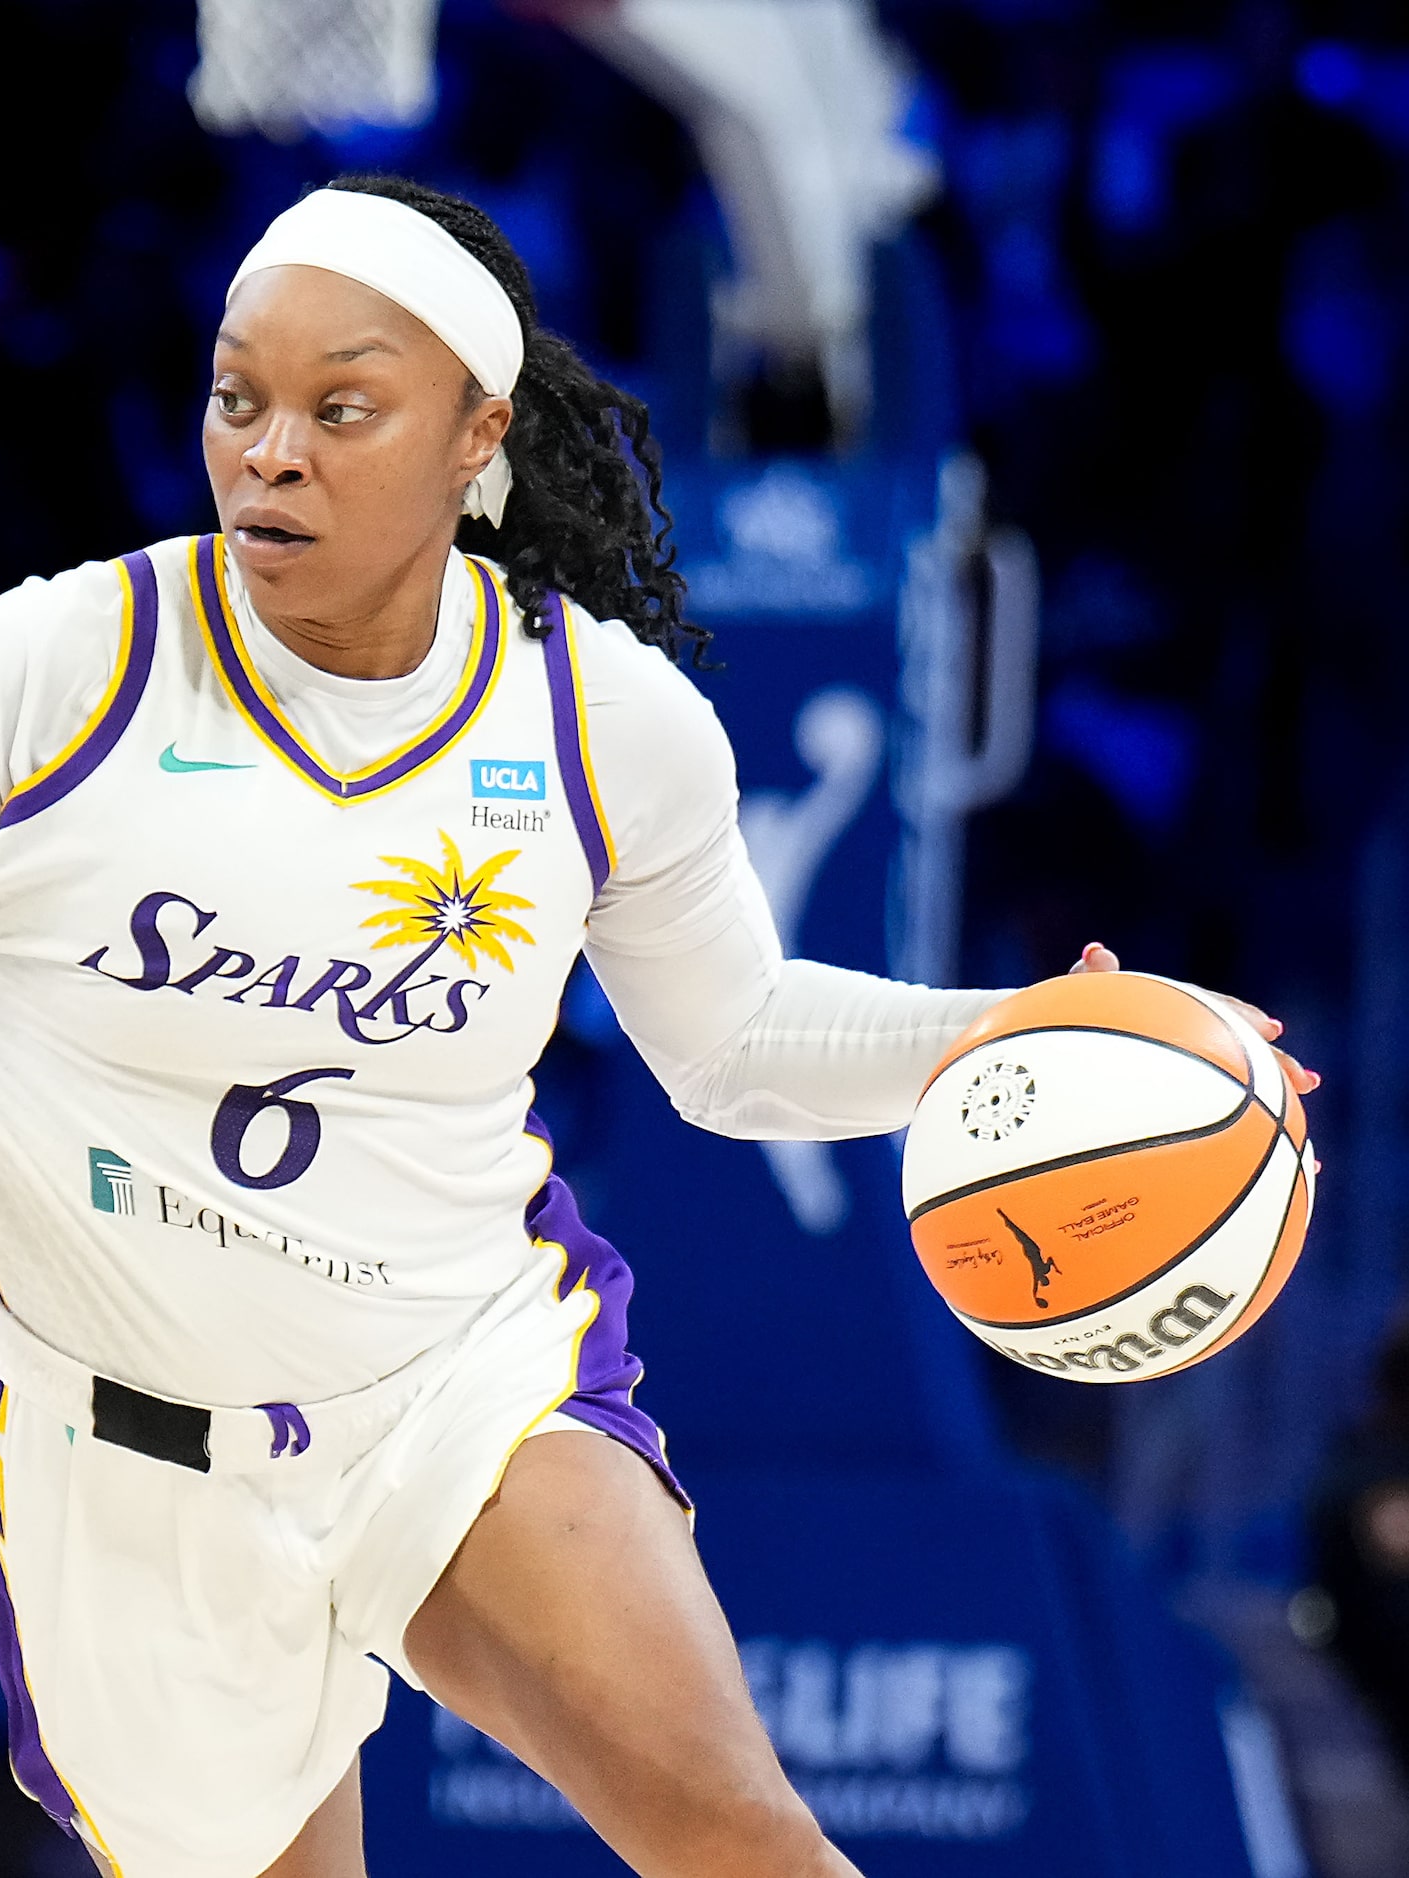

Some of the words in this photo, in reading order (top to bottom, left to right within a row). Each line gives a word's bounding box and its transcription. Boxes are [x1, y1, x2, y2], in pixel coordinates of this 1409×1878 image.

[480, 766, 539, 792] UCLA
[77, 892, 490, 1045] SPARKS
[211, 1067, 356, 1190] 6
[1095, 1196, 1139, 1221] GAME
[1057, 1215, 1095, 1233] BALL
[1071, 1212, 1135, 1241] OFFICIAL
[1053, 1335, 1080, 1346] NXT
[1082, 1325, 1111, 1339] EVO
